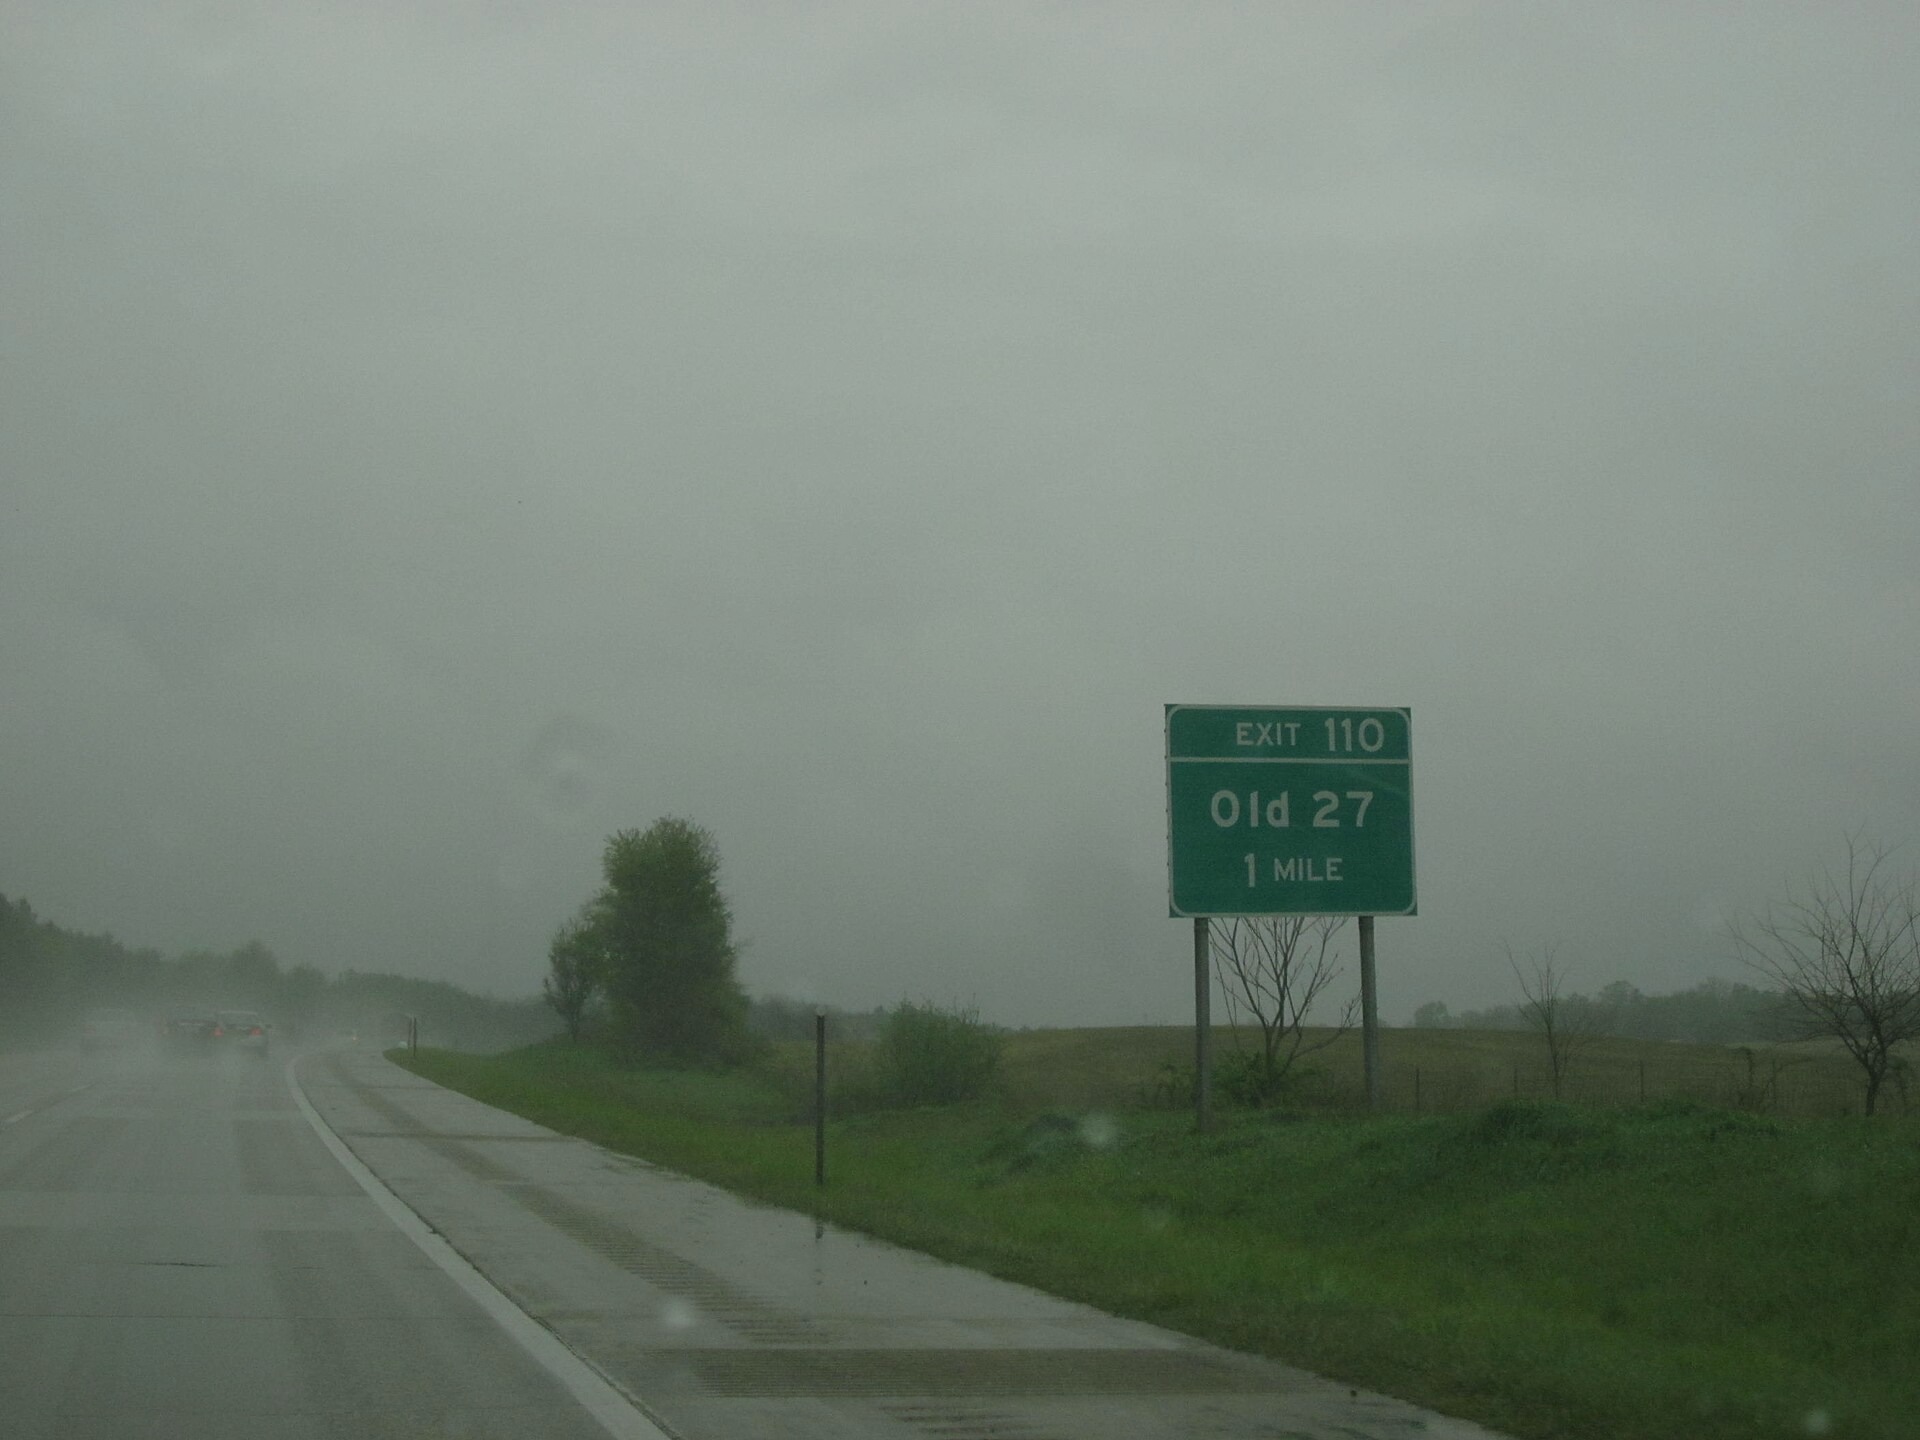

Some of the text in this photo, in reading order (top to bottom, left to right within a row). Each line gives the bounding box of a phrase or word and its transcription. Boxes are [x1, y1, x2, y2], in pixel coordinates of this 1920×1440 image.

[1235, 717, 1385, 753] EXIT 110
[1210, 789, 1374, 829] Old 27
[1243, 852, 1344, 889] 1 MILE
